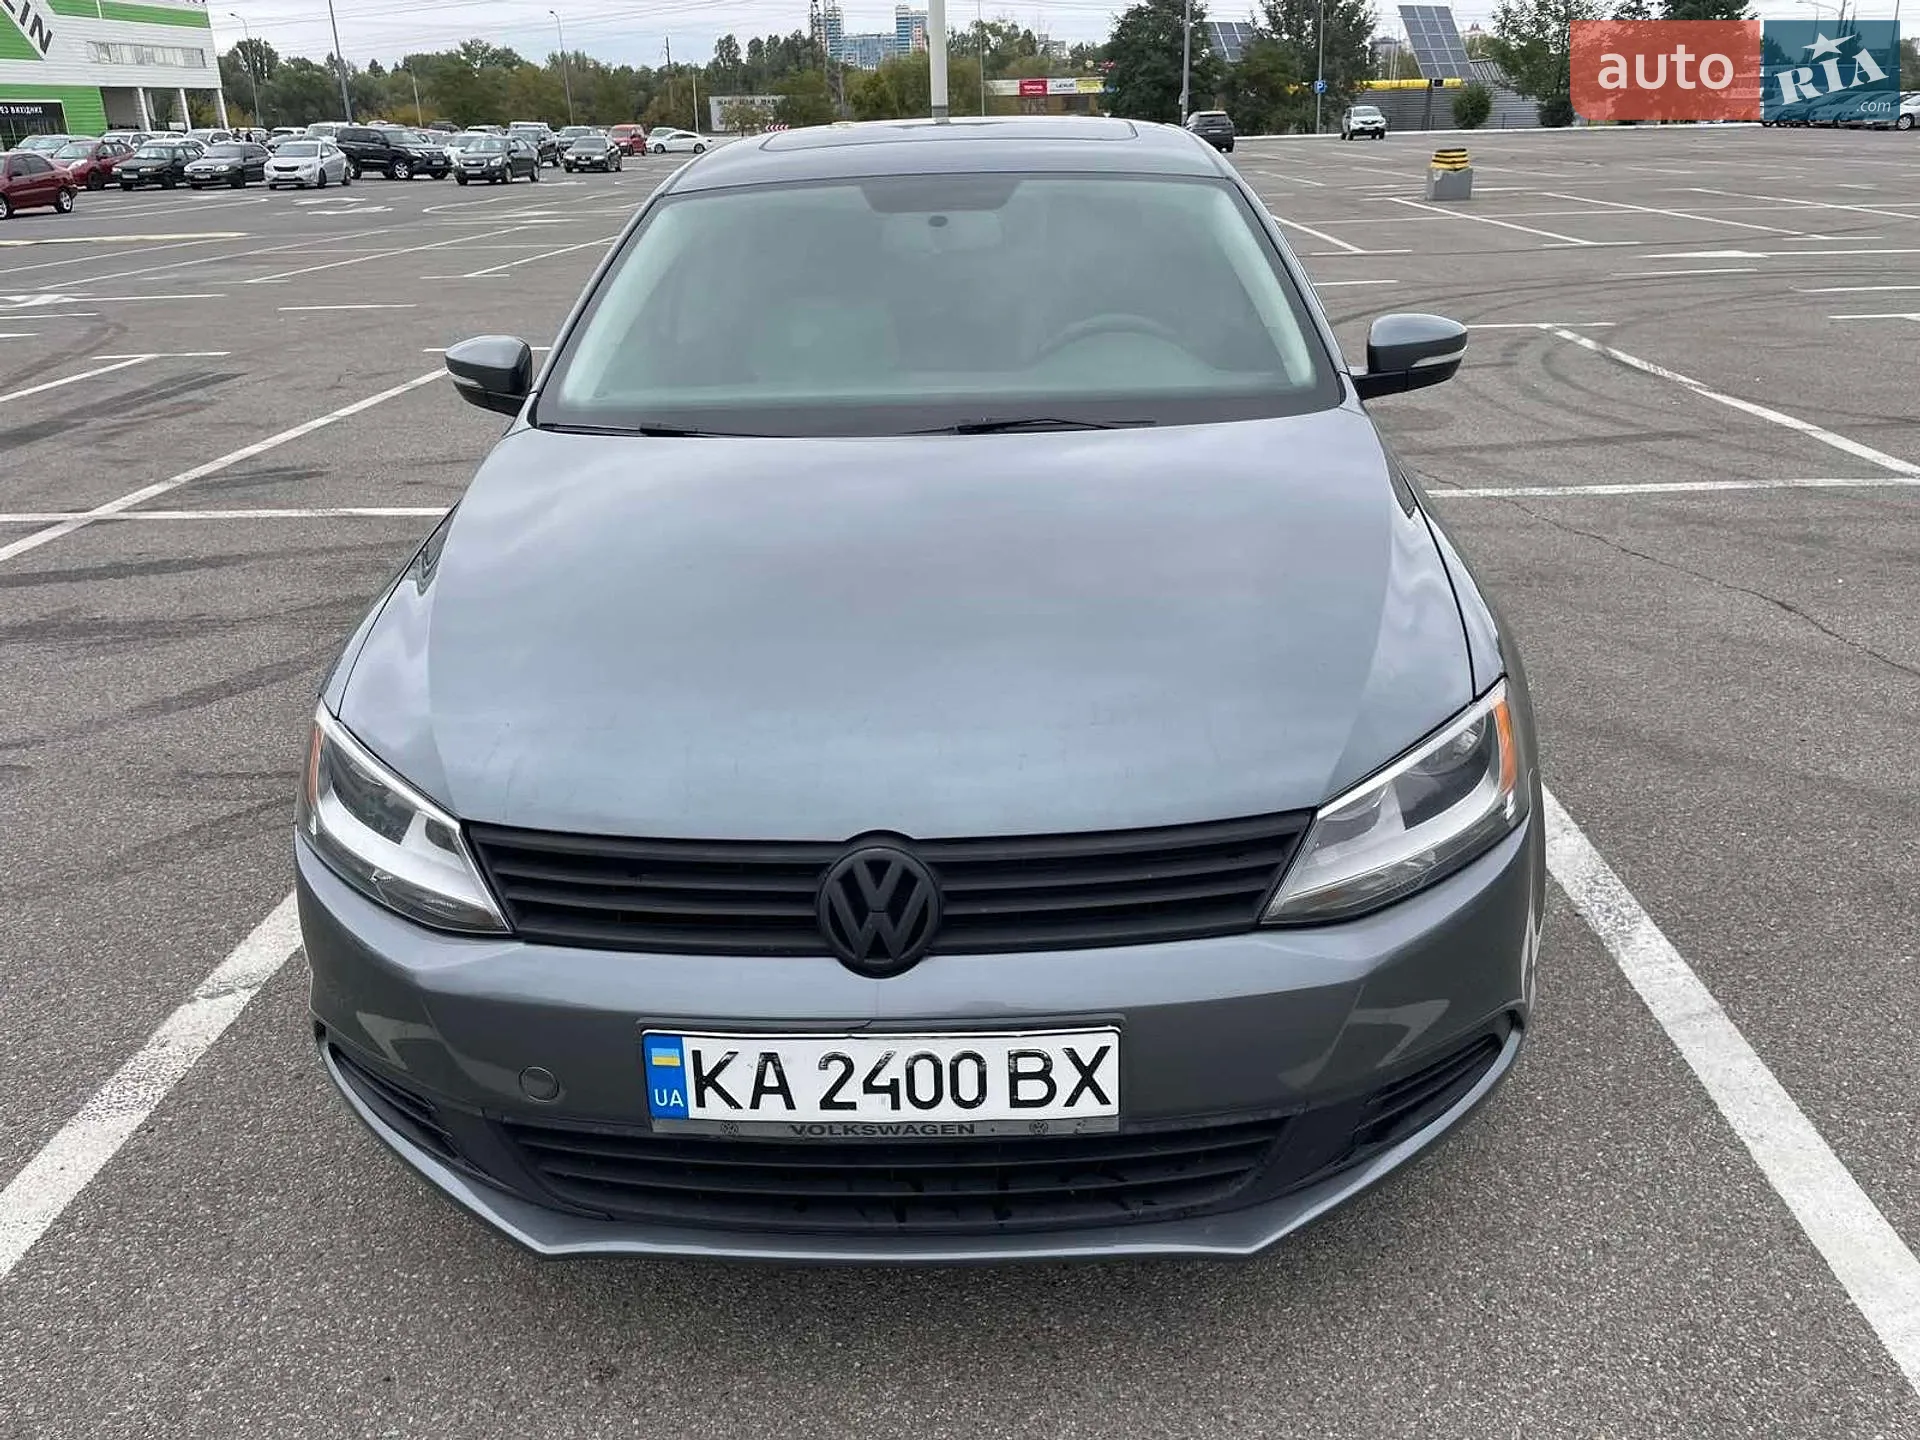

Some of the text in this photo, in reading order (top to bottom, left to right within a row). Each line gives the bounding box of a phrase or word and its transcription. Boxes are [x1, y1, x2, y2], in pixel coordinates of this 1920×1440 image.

[691, 1045, 1112, 1110] KA 2400 BX
[654, 1088, 684, 1107] UA
[789, 1124, 975, 1137] VOLKSWAGEN
